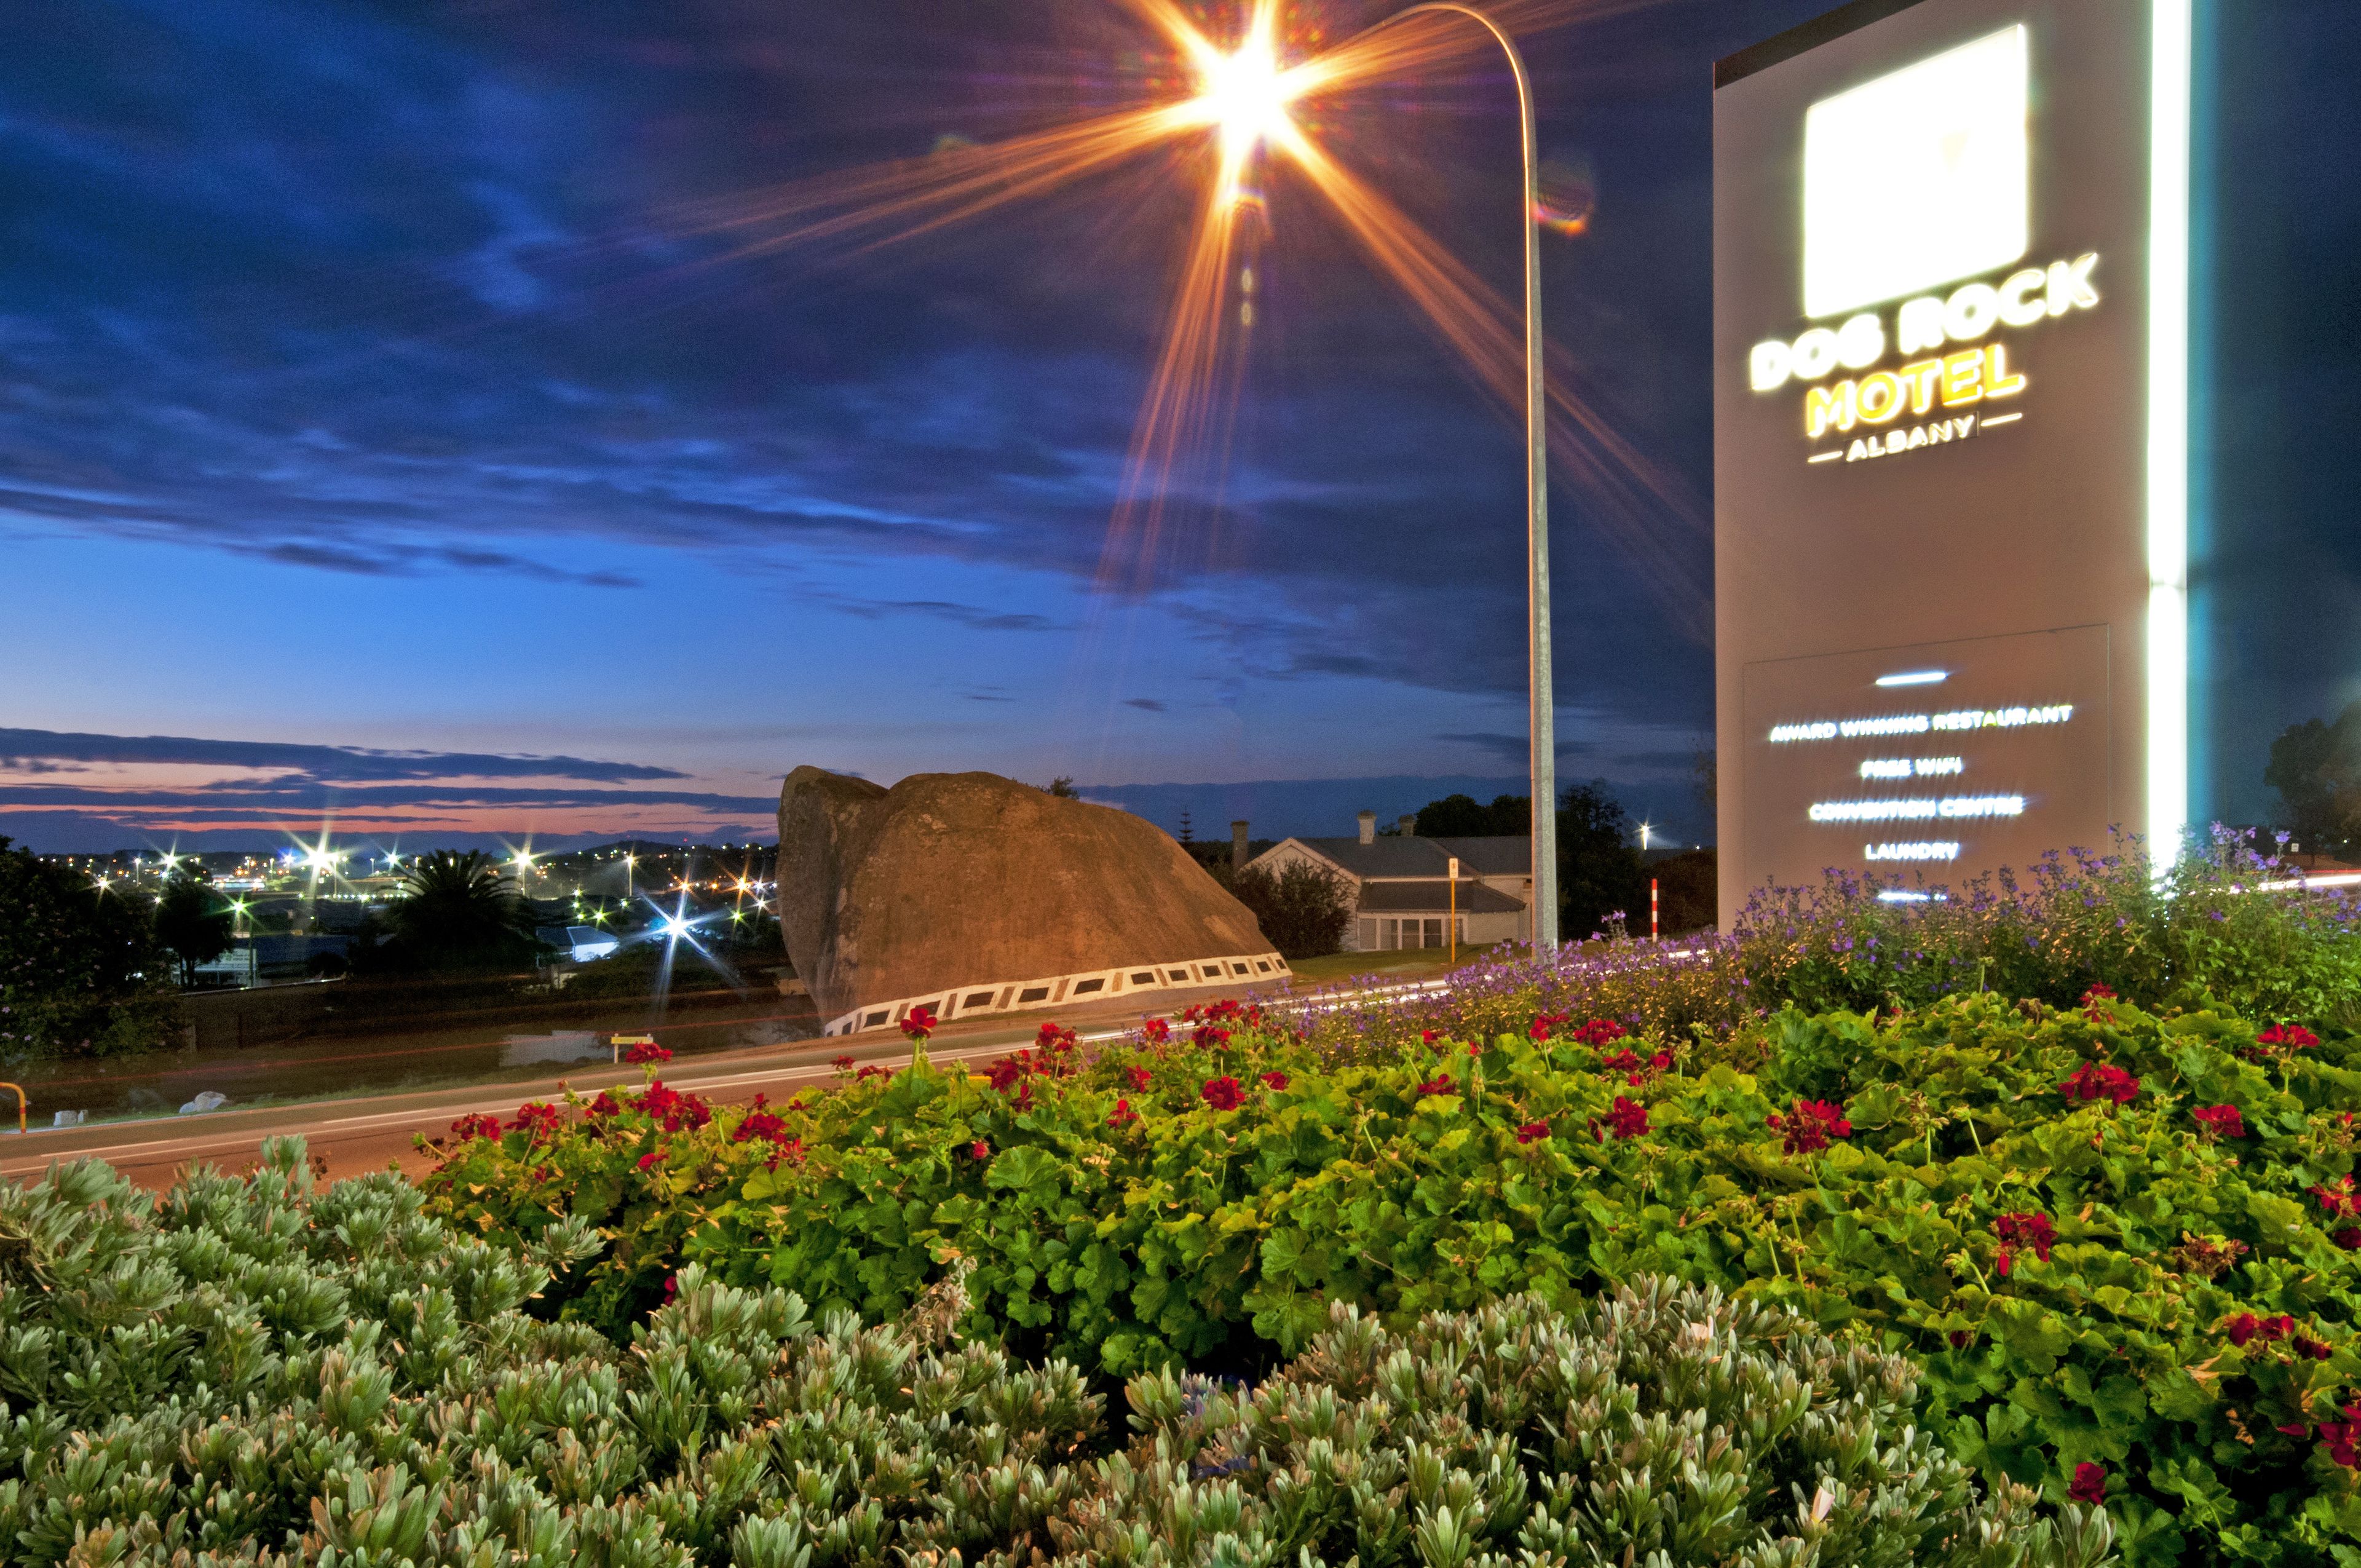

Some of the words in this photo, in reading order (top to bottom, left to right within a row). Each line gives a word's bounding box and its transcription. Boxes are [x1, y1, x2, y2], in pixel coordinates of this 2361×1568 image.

[1750, 314, 1884, 391] DOG
[1899, 253, 2099, 354] ROCK
[1807, 344, 2026, 437] MOTEL
[1846, 414, 1975, 461] ALBANY
[1770, 722, 1837, 742] AWARD
[1840, 716, 1930, 736] WINNING
[1933, 705, 2073, 731] RESTAURANT
[1861, 759, 1912, 778] FREE
[1809, 800, 1937, 820] CONVENTION
[1939, 796, 2024, 816] CENTRE
[1865, 842, 1960, 861] LAUNDRY
